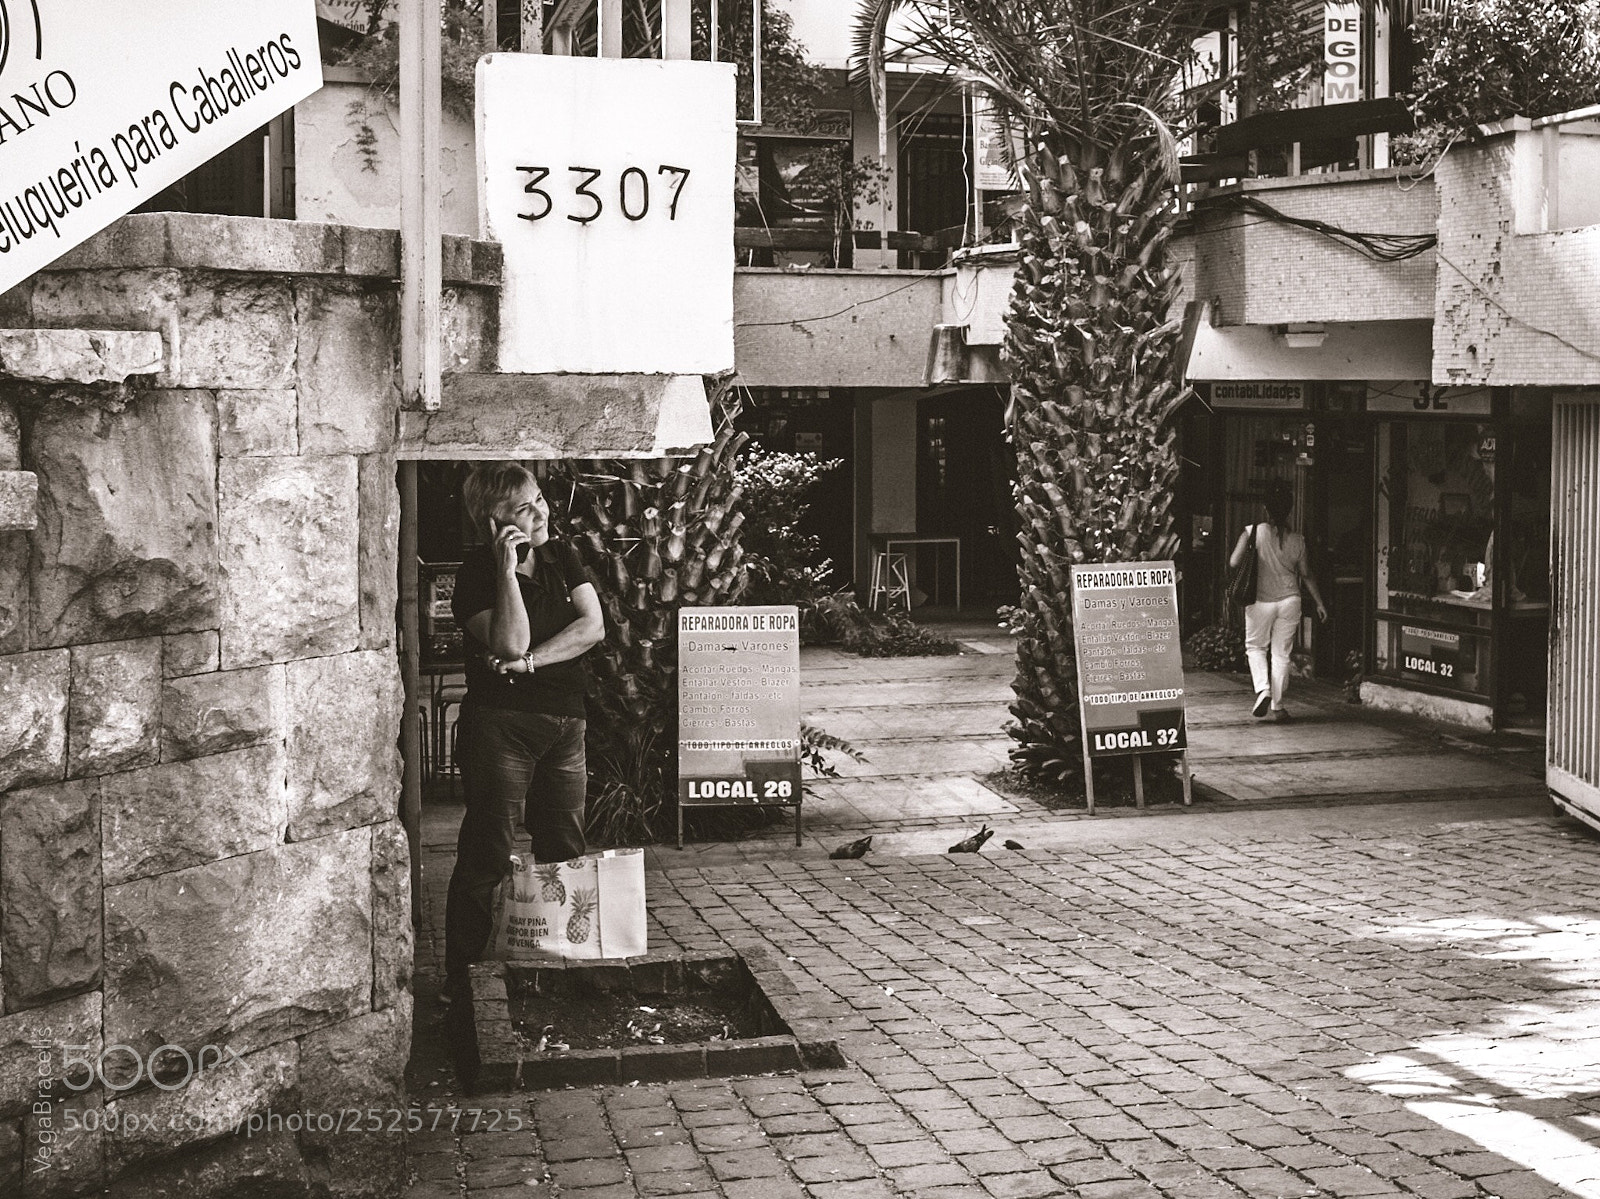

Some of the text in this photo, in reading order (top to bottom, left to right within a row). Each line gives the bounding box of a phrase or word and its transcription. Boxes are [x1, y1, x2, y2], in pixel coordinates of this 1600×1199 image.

[1327, 18, 1358, 32] DE
[111, 109, 179, 189] para
[169, 33, 302, 134] Caballeros
[515, 164, 691, 226] 3307
[1413, 380, 1449, 411] 32
[1076, 569, 1174, 589] REPARADORA DE ROPA
[1120, 599, 1126, 611] y
[681, 615, 796, 631] REPARADORA DE ROPA
[1147, 617, 1177, 630] Mangas
[761, 664, 797, 676] Mangas
[1405, 655, 1454, 678] LOCAL 32
[1111, 693, 1128, 703] TIPO
[682, 704, 751, 714] Cambio Forros
[724, 717, 757, 727] Bastas
[1094, 728, 1179, 751] LOCAL 32
[688, 780, 793, 799] LOCAL 28
[530, 927, 549, 937] BIEN
